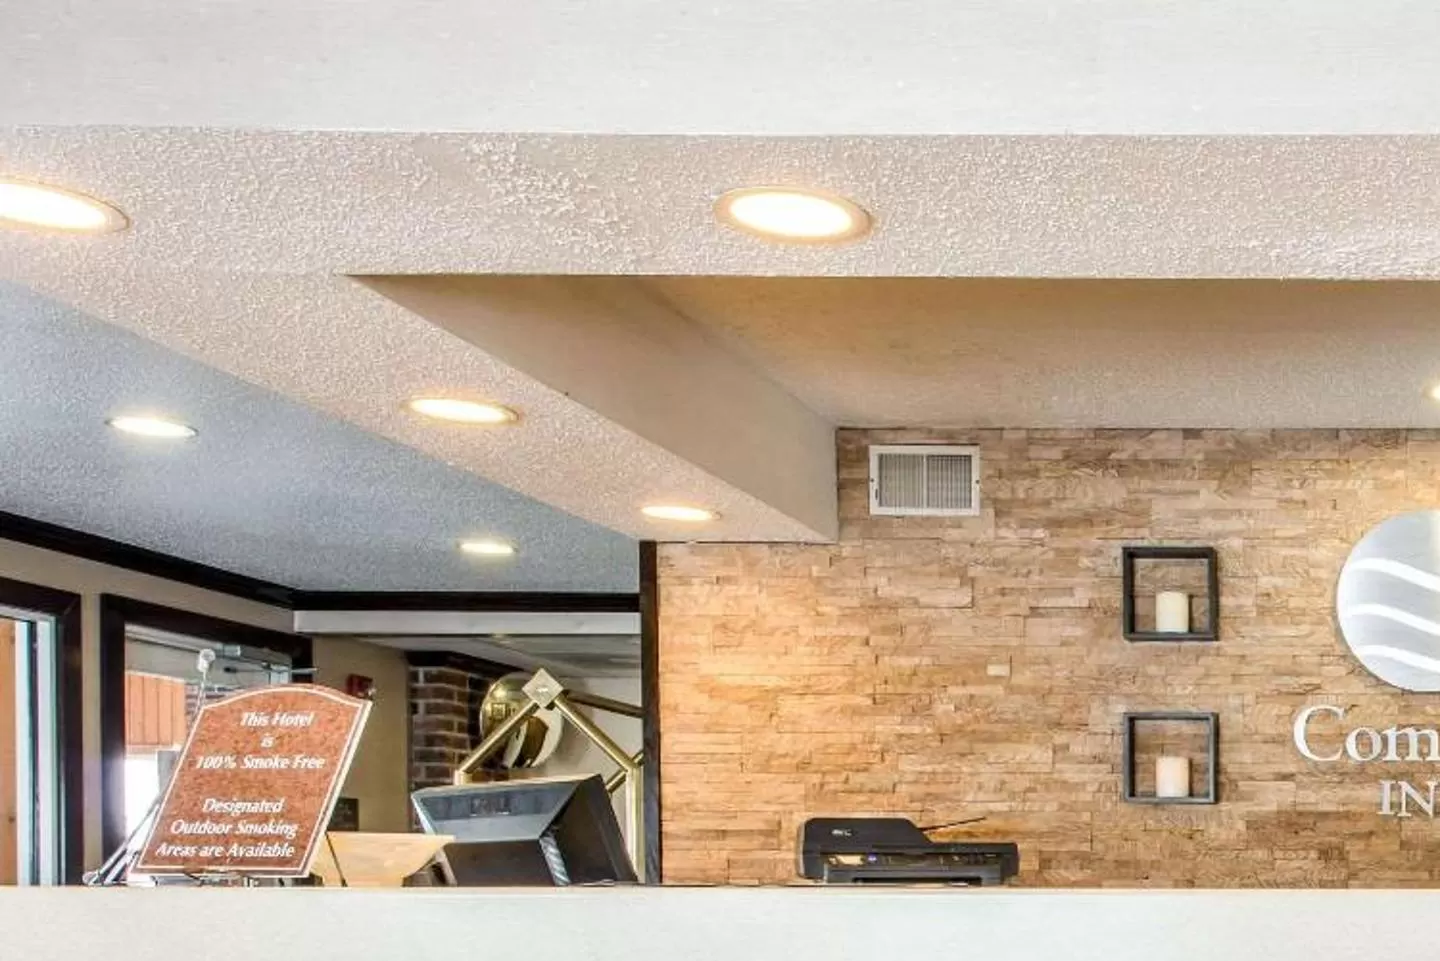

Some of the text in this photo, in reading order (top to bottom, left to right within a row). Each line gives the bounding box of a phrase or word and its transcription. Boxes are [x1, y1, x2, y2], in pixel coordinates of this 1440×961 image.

[241, 711, 315, 727] This Hotel
[260, 731, 275, 748] is
[196, 754, 326, 769] 100% Smoke Free
[202, 797, 285, 817] Designated
[170, 819, 299, 839] Outdoor Smoking
[155, 841, 295, 857] Areas are Available
